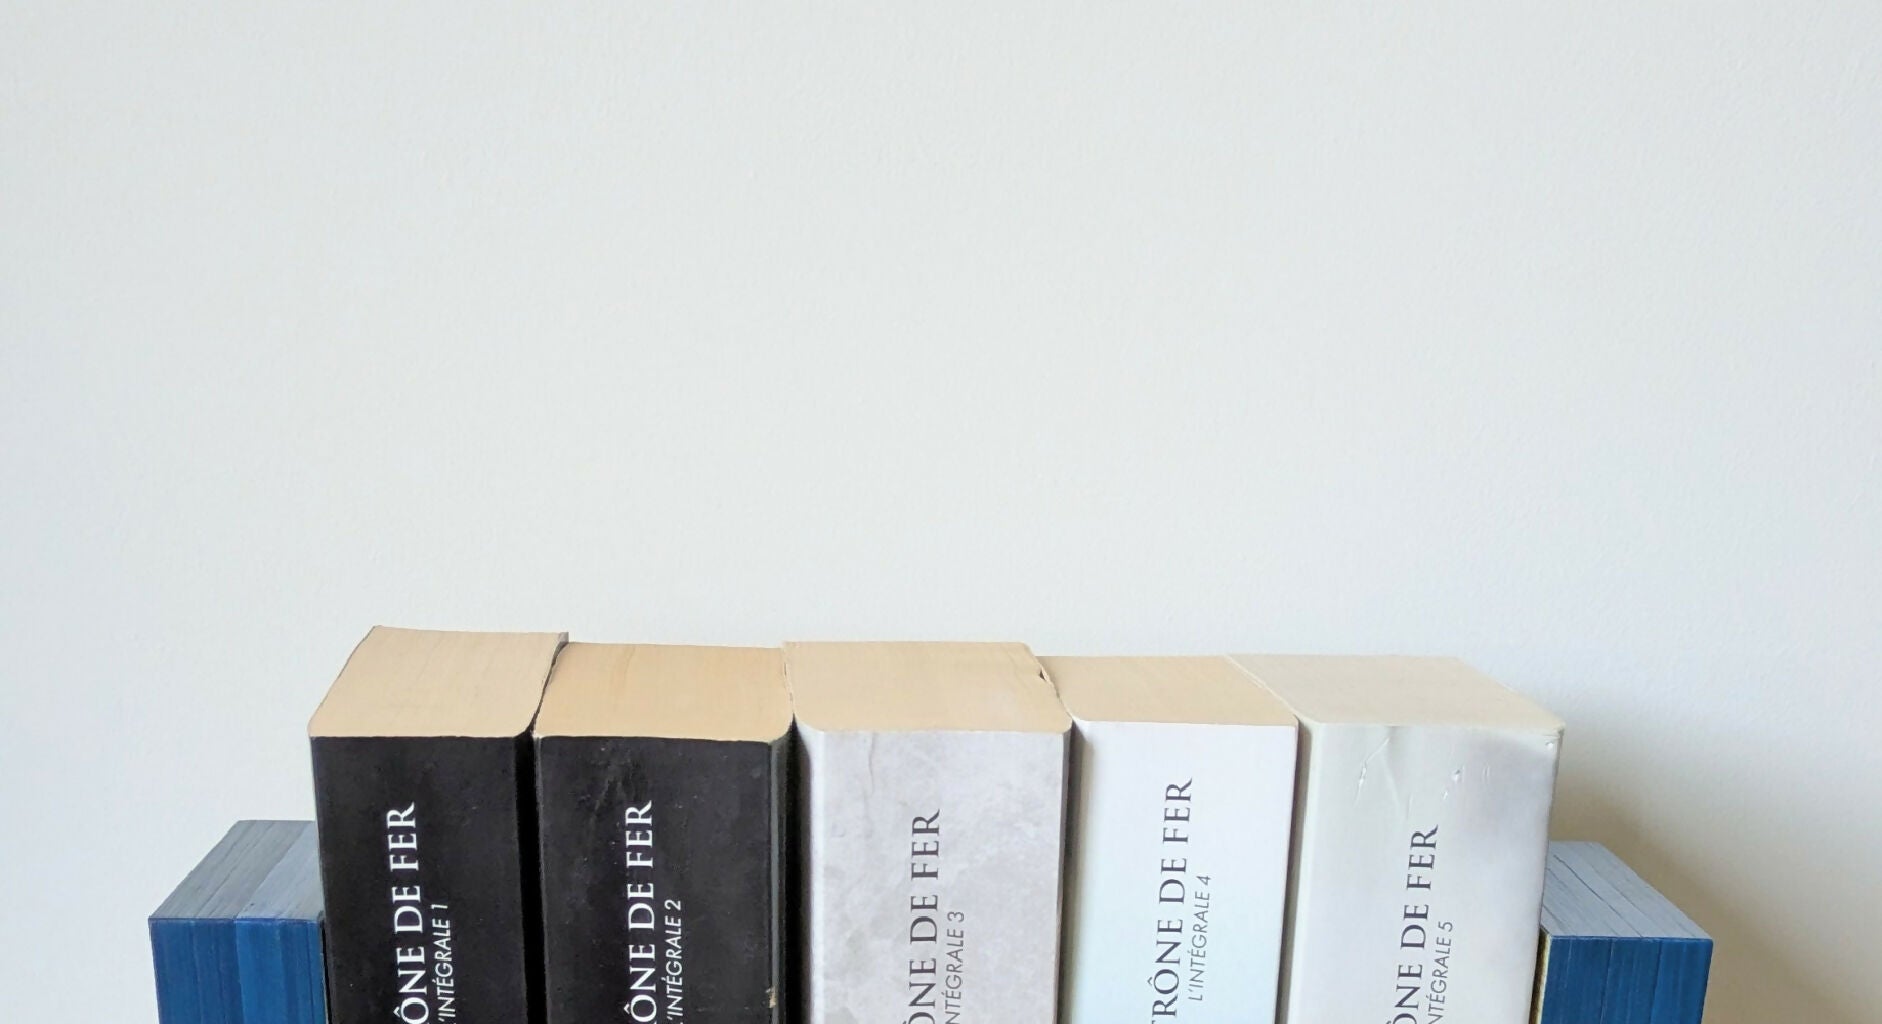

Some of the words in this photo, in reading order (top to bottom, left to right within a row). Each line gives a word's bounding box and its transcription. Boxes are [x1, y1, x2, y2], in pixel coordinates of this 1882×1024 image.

[624, 799, 654, 869] FER
[1162, 777, 1193, 844] FER
[385, 801, 420, 873] FER
[910, 808, 941, 881] FER
[1405, 824, 1439, 891] FER
[663, 898, 682, 912] 2
[1158, 857, 1188, 905] DE
[1196, 875, 1211, 886] 4
[390, 884, 424, 935] DE
[625, 882, 656, 932] DE
[909, 894, 939, 945] DE
[946, 911, 965, 923] 3
[1399, 903, 1430, 950] DE
[1437, 921, 1454, 933] 5
[1187, 891, 1211, 1002] L'INTÉGRALE
